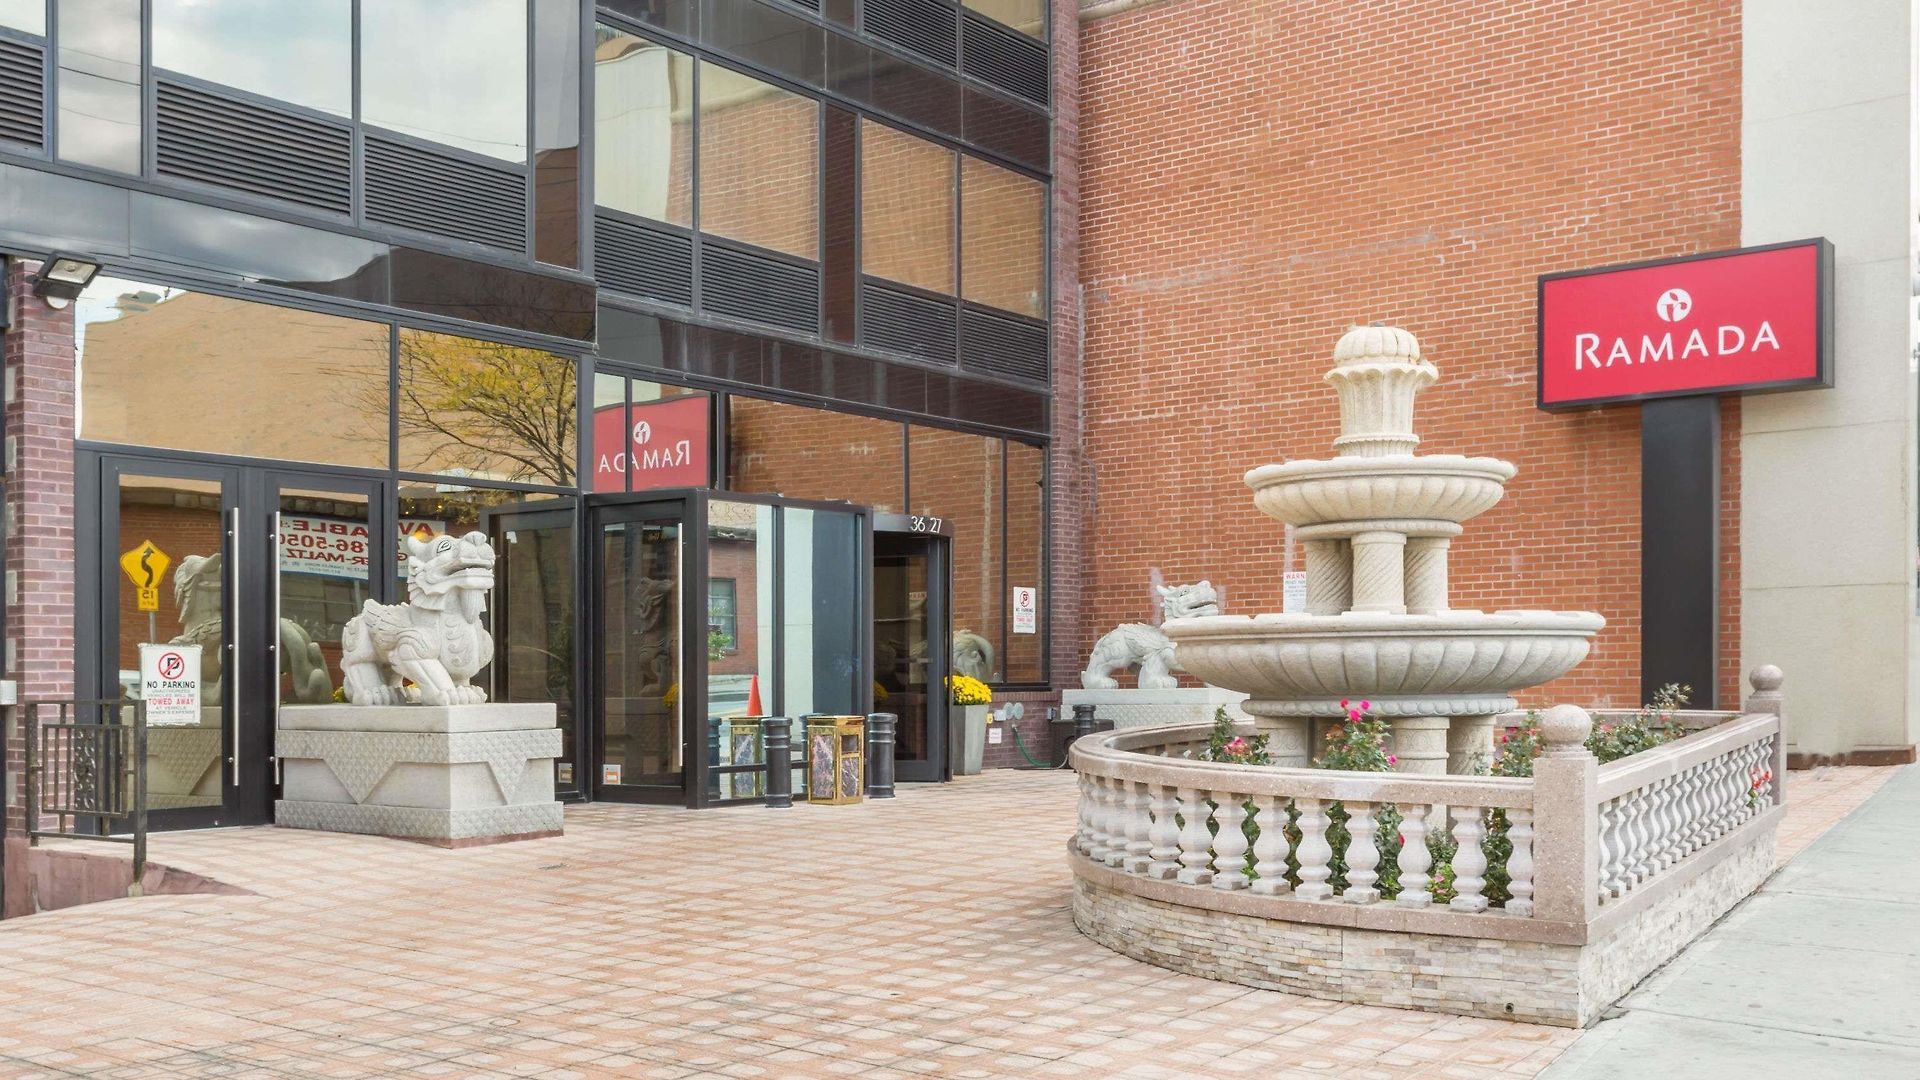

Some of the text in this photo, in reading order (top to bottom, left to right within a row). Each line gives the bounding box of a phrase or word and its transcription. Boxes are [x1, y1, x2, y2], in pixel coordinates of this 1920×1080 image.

[1576, 321, 1780, 370] RAMADA
[910, 515, 942, 534] 36 27
[147, 681, 195, 689] NO PARKING
